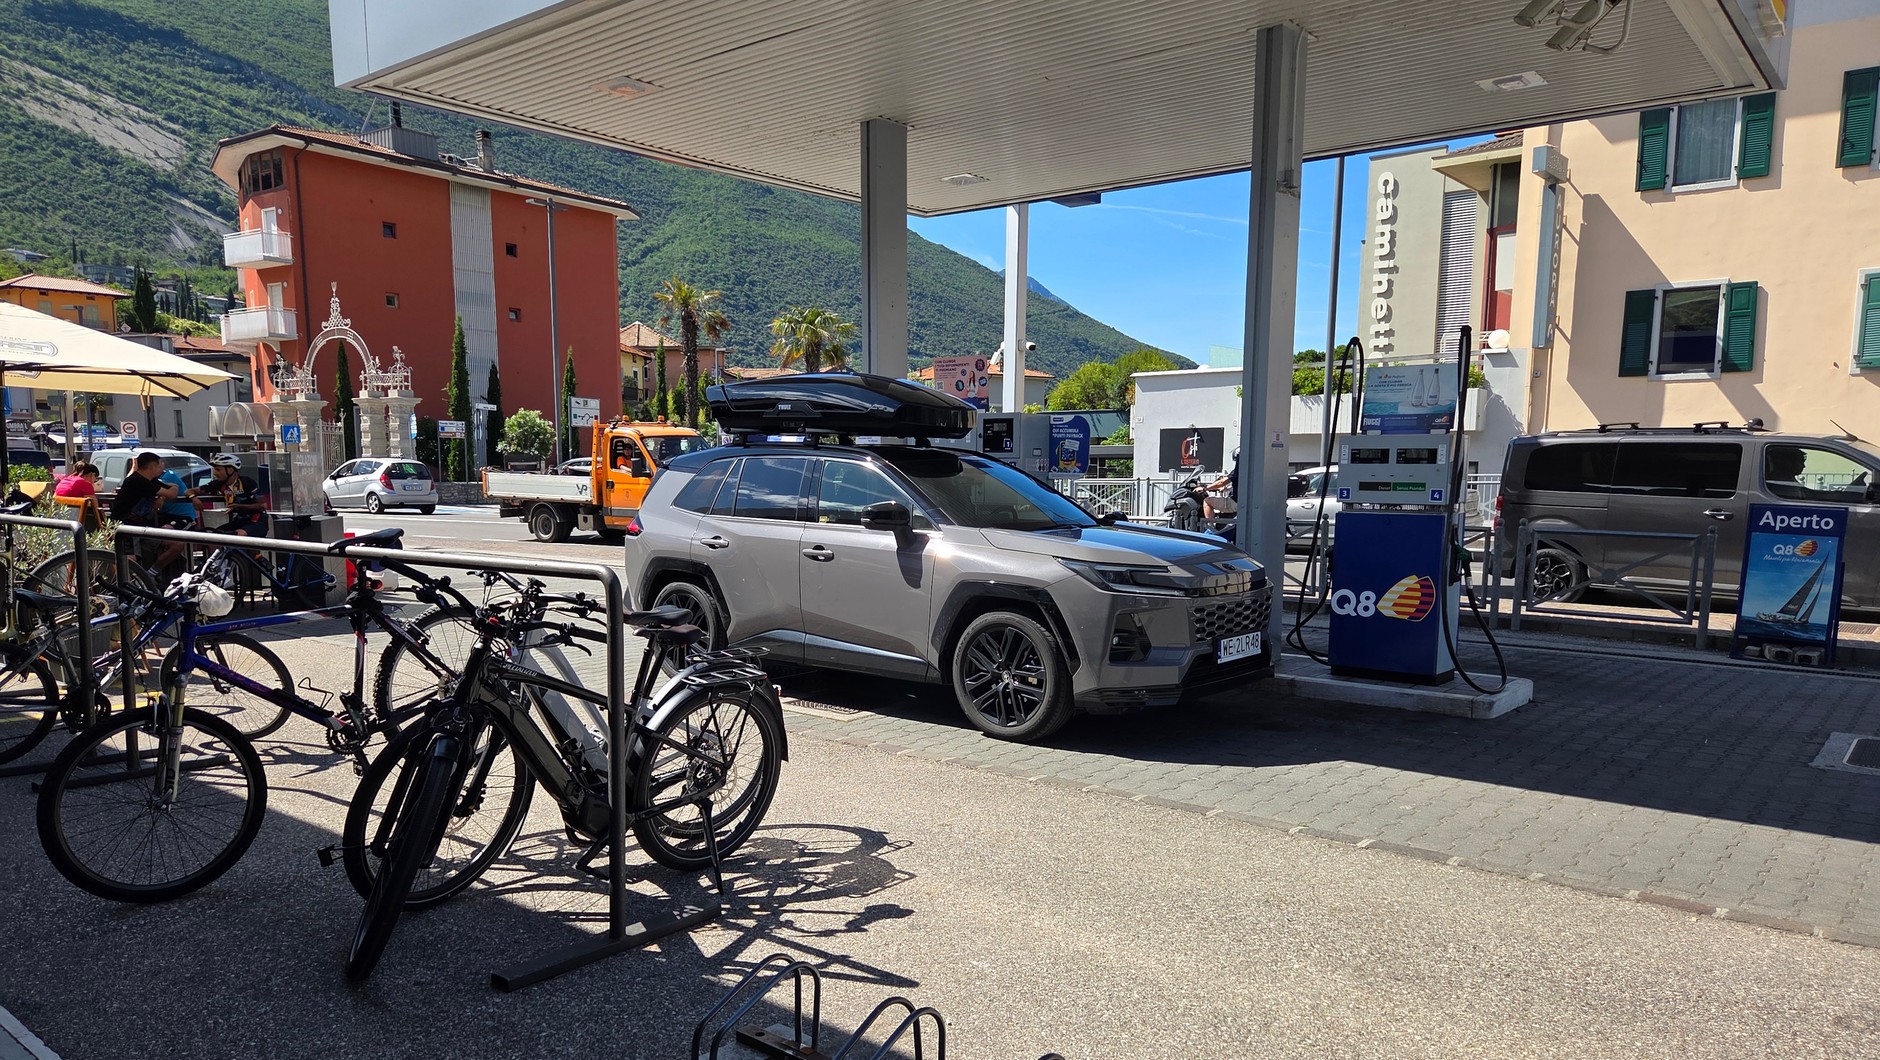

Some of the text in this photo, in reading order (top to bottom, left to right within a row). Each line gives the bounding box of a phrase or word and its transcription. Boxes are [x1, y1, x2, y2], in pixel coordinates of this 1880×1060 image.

[1759, 510, 1834, 531] Aperto
[1773, 544, 1794, 555] Q8
[1331, 588, 1376, 617] Q8
[1236, 633, 1260, 654] 2LR48
